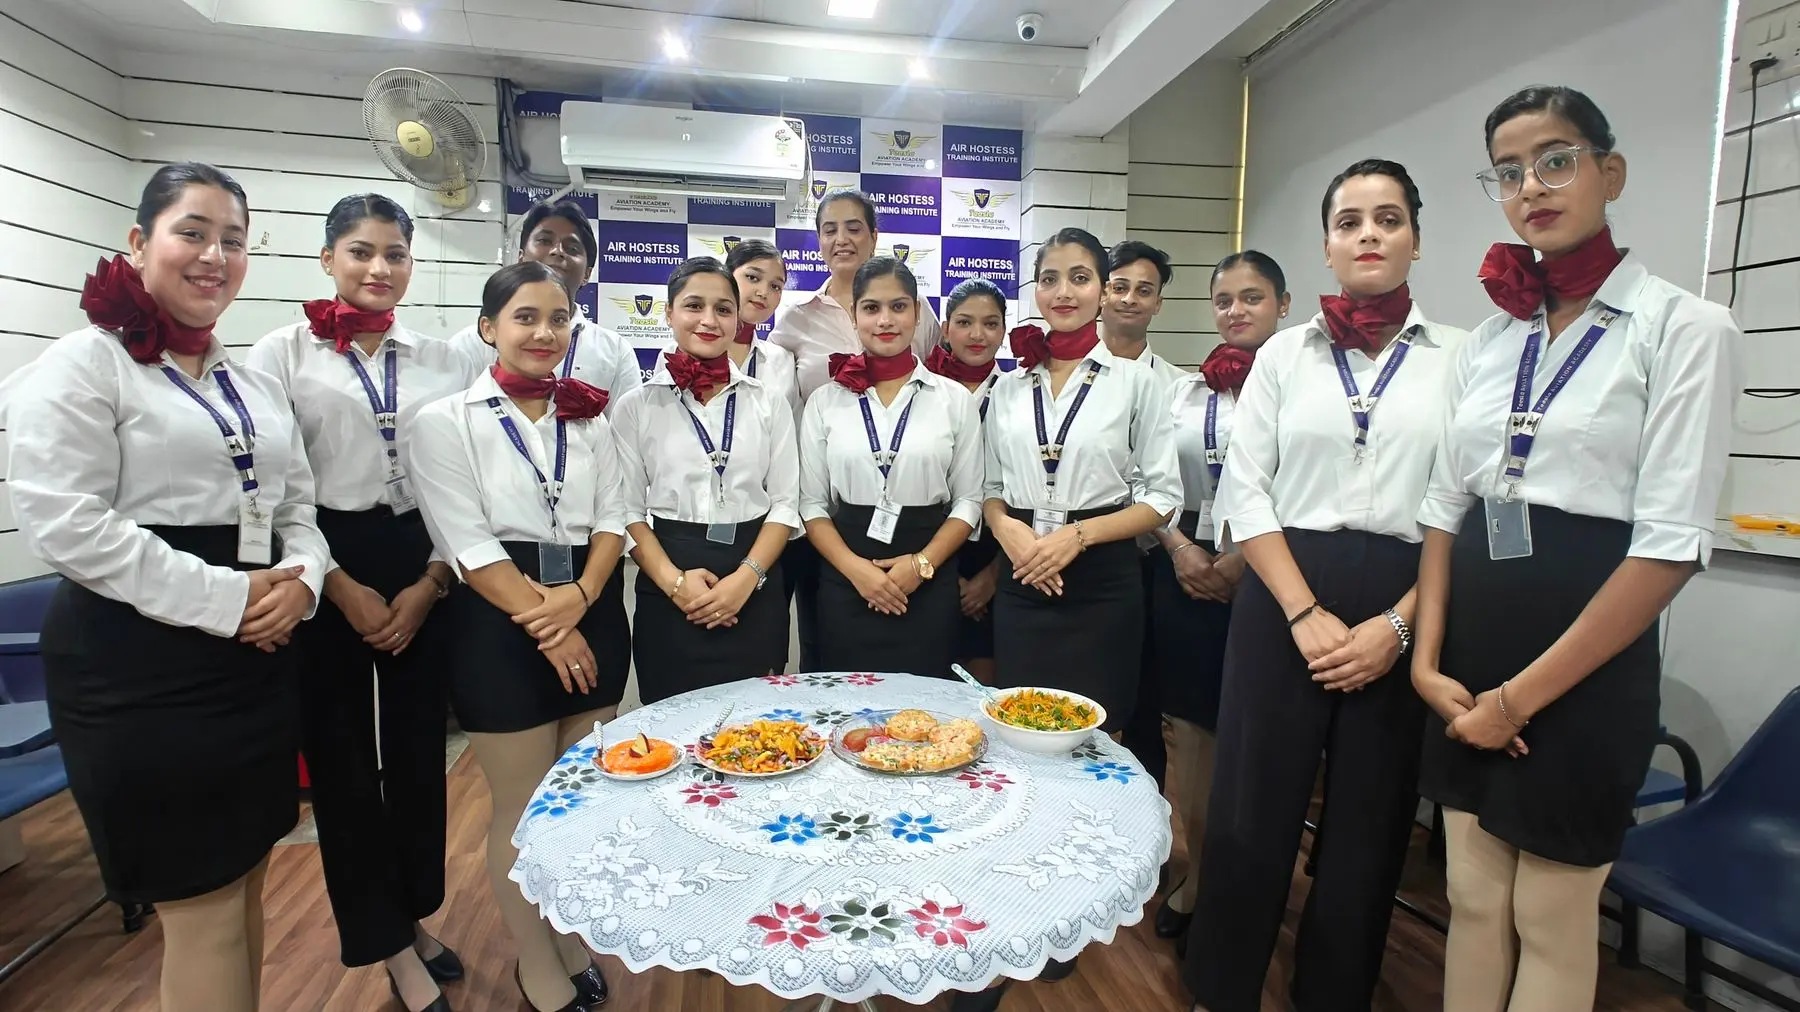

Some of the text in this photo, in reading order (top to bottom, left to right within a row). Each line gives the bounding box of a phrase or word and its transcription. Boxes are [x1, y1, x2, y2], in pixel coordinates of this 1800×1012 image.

[818, 146, 857, 155] INSTITUTE
[950, 143, 1015, 155] AIR HOSTESS
[946, 153, 1018, 163] TRAINING INSTITUTE
[693, 197, 772, 208] TRAINING INSTITUTE
[868, 193, 935, 205] AIR HOSTESS
[874, 206, 938, 217] AINING INSTITUTE
[607, 241, 680, 254] AIR HOSTESS
[603, 254, 684, 265] TRAINING INSTITUTE
[781, 250, 800, 260] AIR
[948, 257, 1013, 270] AIR HOSTESS
[944, 269, 1016, 281] TRAINING INSTITUTE
[1551, 365, 1573, 393] AVIATION
[1571, 338, 1592, 365] ACADEMY
